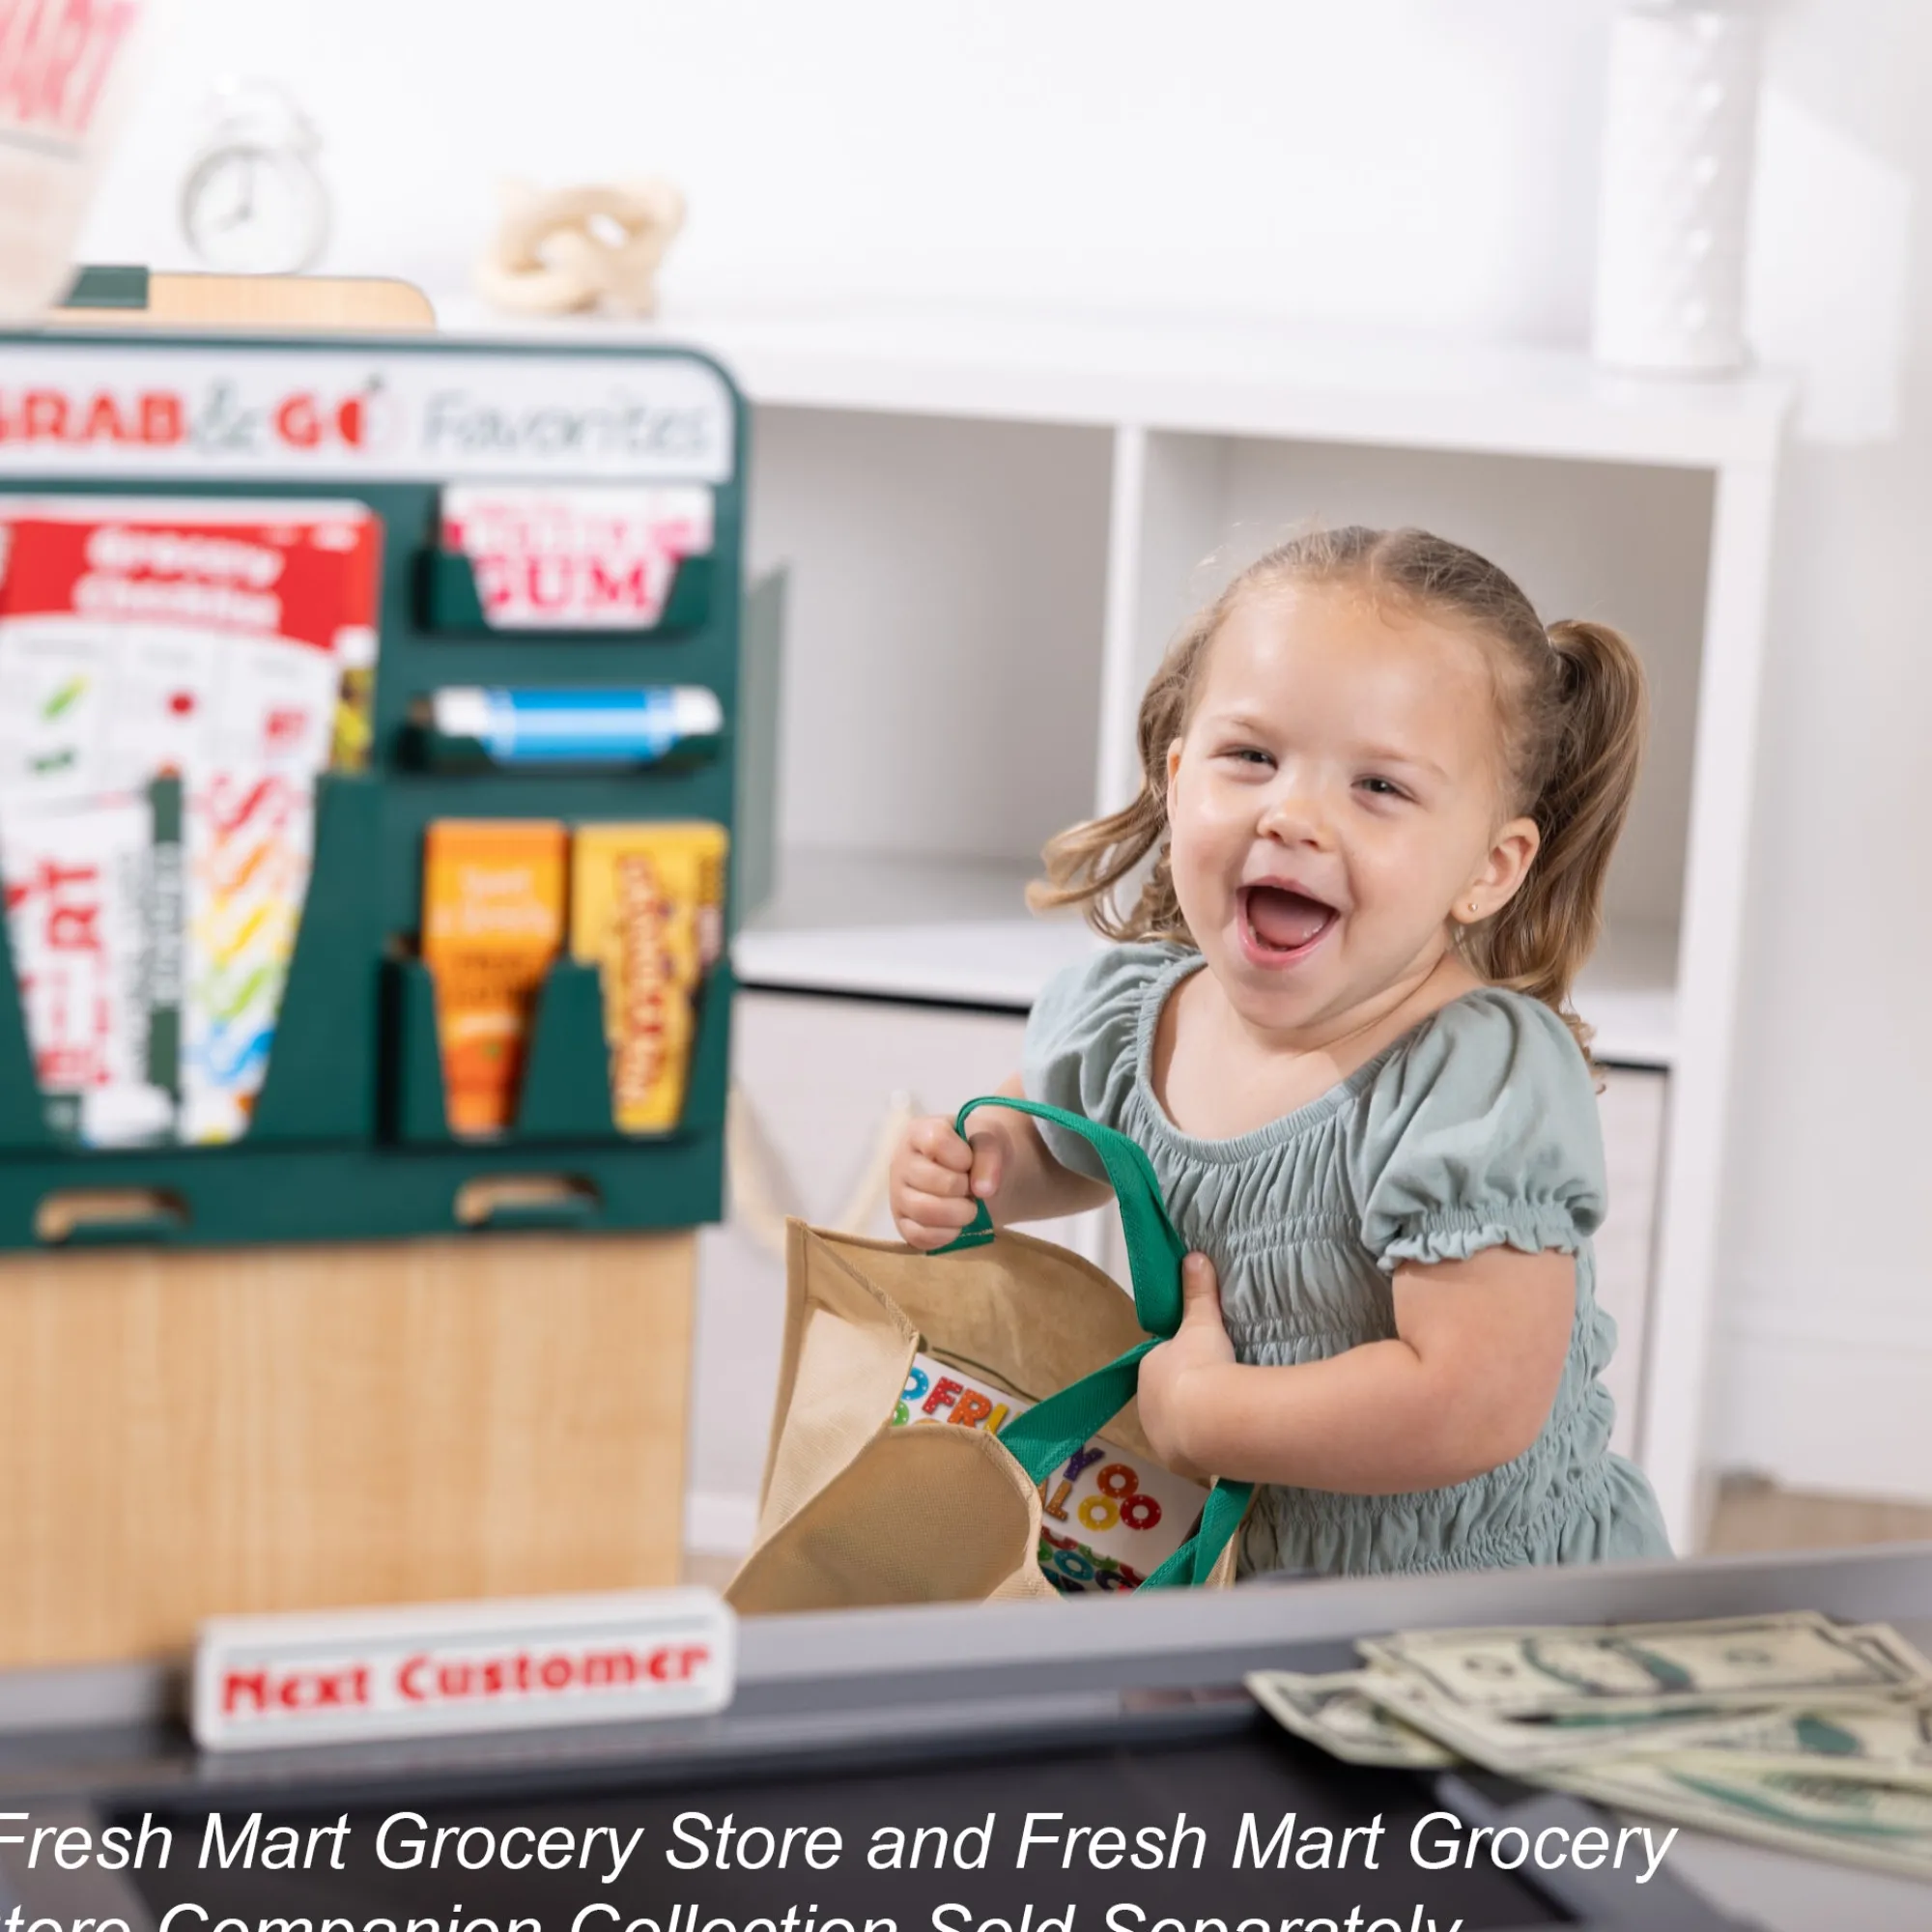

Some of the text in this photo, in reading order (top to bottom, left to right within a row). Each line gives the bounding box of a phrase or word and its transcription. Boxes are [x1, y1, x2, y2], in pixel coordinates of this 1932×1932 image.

[0, 389, 184, 446] RAB
[220, 1643, 711, 1716] Next Customer
